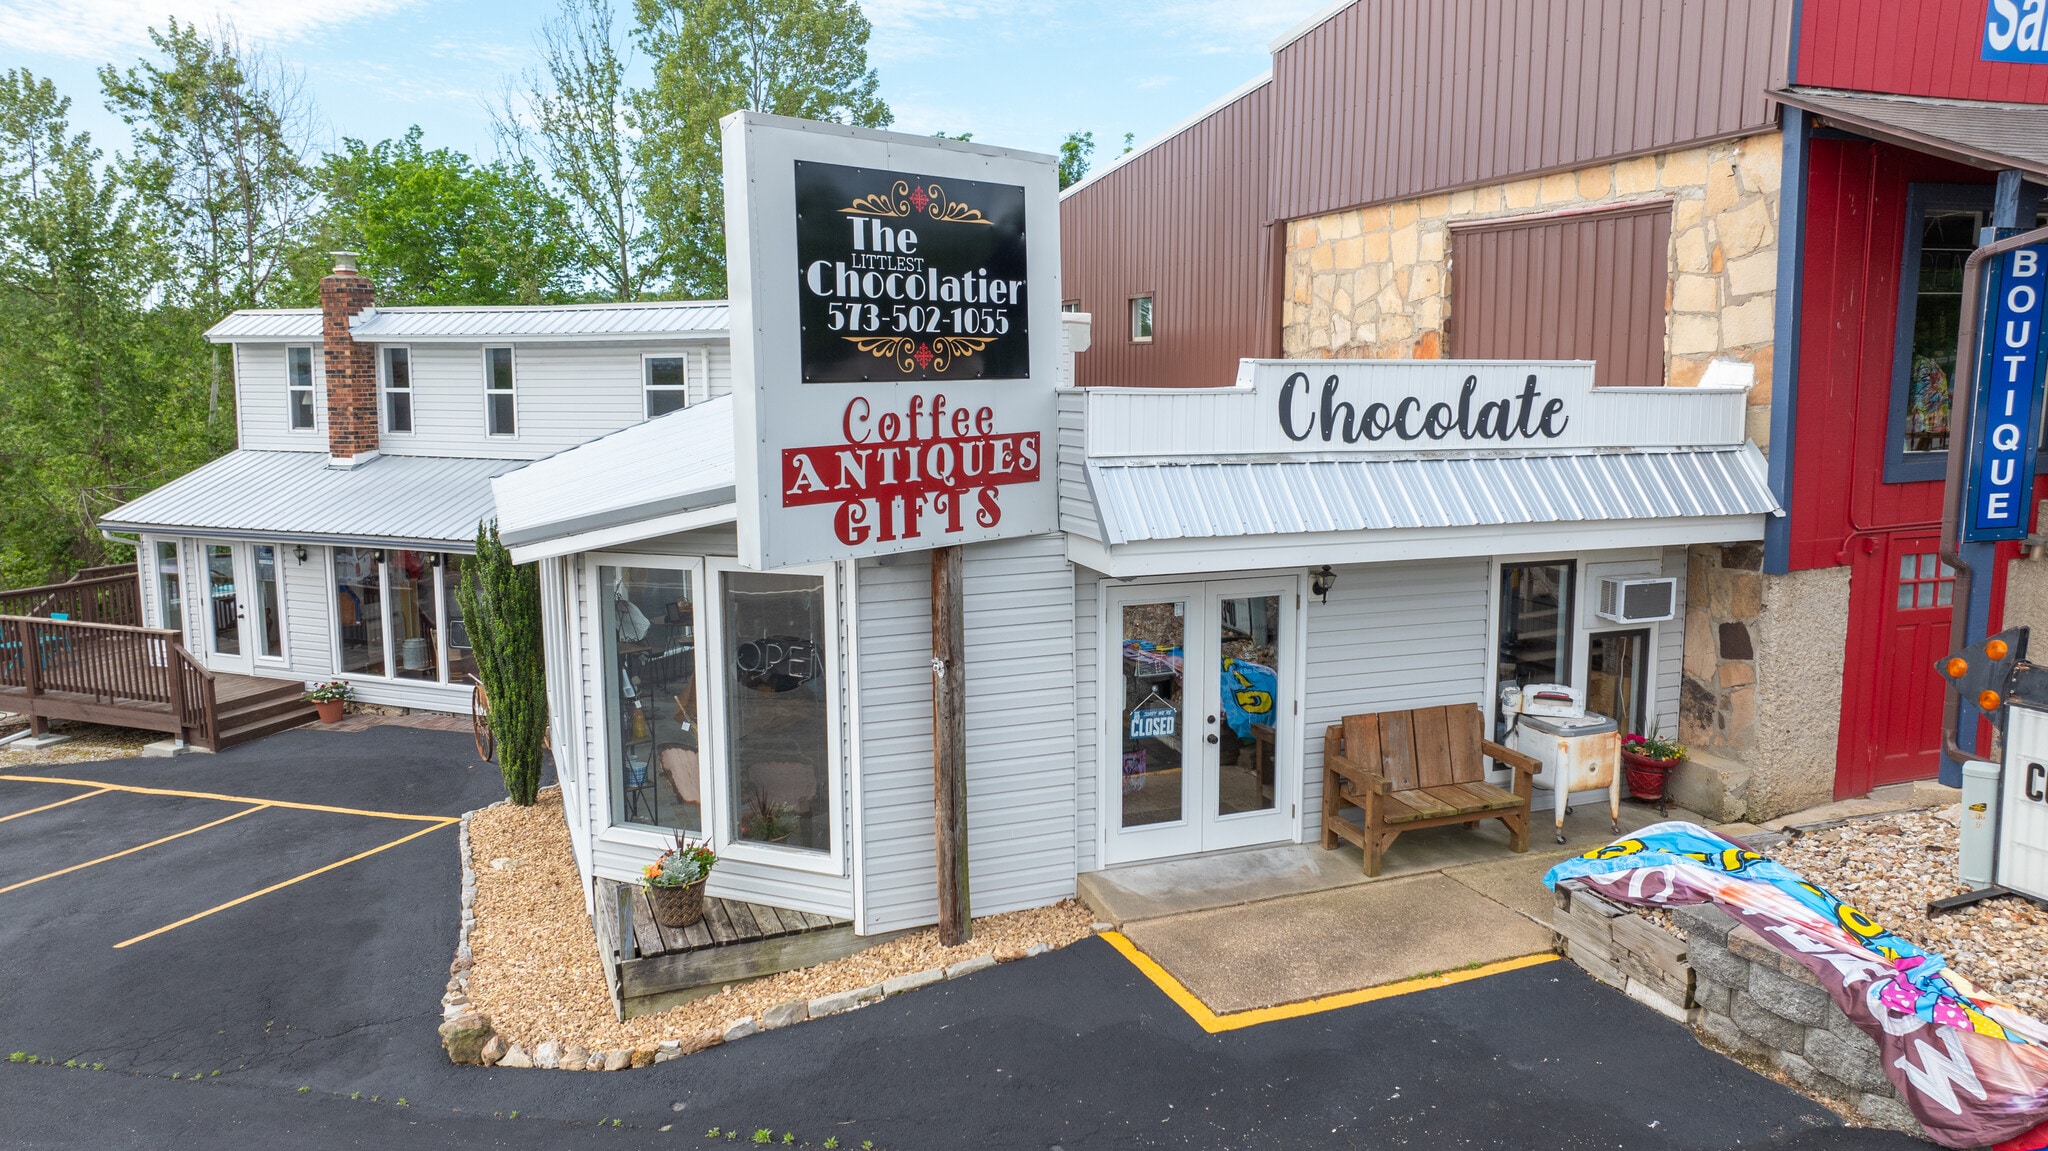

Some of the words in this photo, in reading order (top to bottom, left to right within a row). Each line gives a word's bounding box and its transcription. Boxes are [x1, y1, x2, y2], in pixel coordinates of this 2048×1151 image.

[847, 216, 918, 254] The
[807, 259, 1022, 305] Chocolatier
[851, 253, 924, 273] LITTLEST
[827, 302, 1009, 335] 573-502-1055
[1278, 371, 1569, 444] Chocolate
[1987, 250, 2038, 519] BOUTIQUE
[843, 394, 993, 444] Coffee
[786, 437, 1038, 495] ANTIQUES
[834, 486, 1001, 546] GIFTS
[1131, 716, 1175, 737] CLOSED
